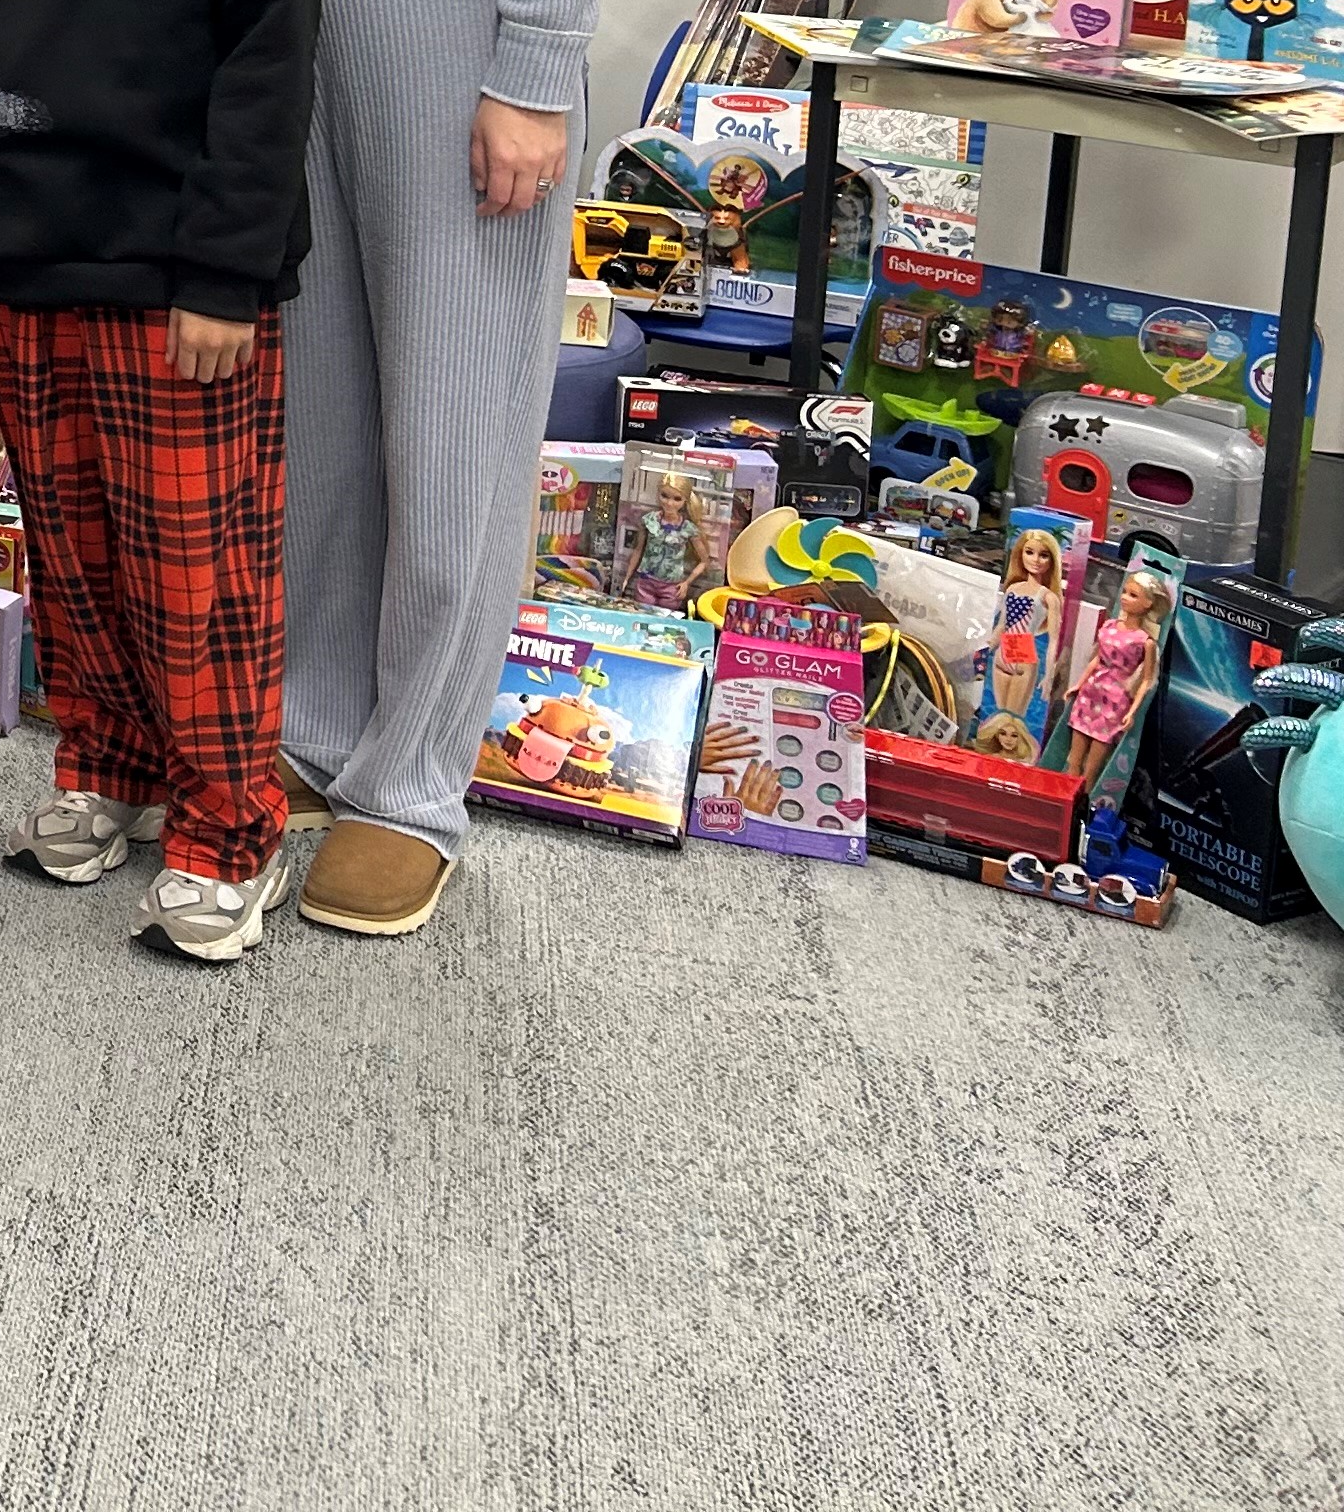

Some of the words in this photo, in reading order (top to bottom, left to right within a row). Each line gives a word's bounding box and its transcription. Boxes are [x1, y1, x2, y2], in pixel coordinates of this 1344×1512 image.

[714, 116, 782, 147] Seek
[887, 254, 979, 287] fisher-price
[630, 400, 658, 413] LEGO
[520, 610, 548, 624] LEGO
[1194, 598, 1226, 621] BRAIN
[1226, 609, 1263, 633] GAMES
[507, 633, 577, 669] RTNITE
[735, 649, 769, 667] GO
[774, 654, 844, 681] GLAM
[795, 671, 824, 683] NAILS
[703, 803, 739, 817] COOL
[1160, 811, 1262, 875] PORTABLE
[1169, 838, 1261, 893] TELESCOPE
[1215, 878, 1260, 909] TRIPOD
